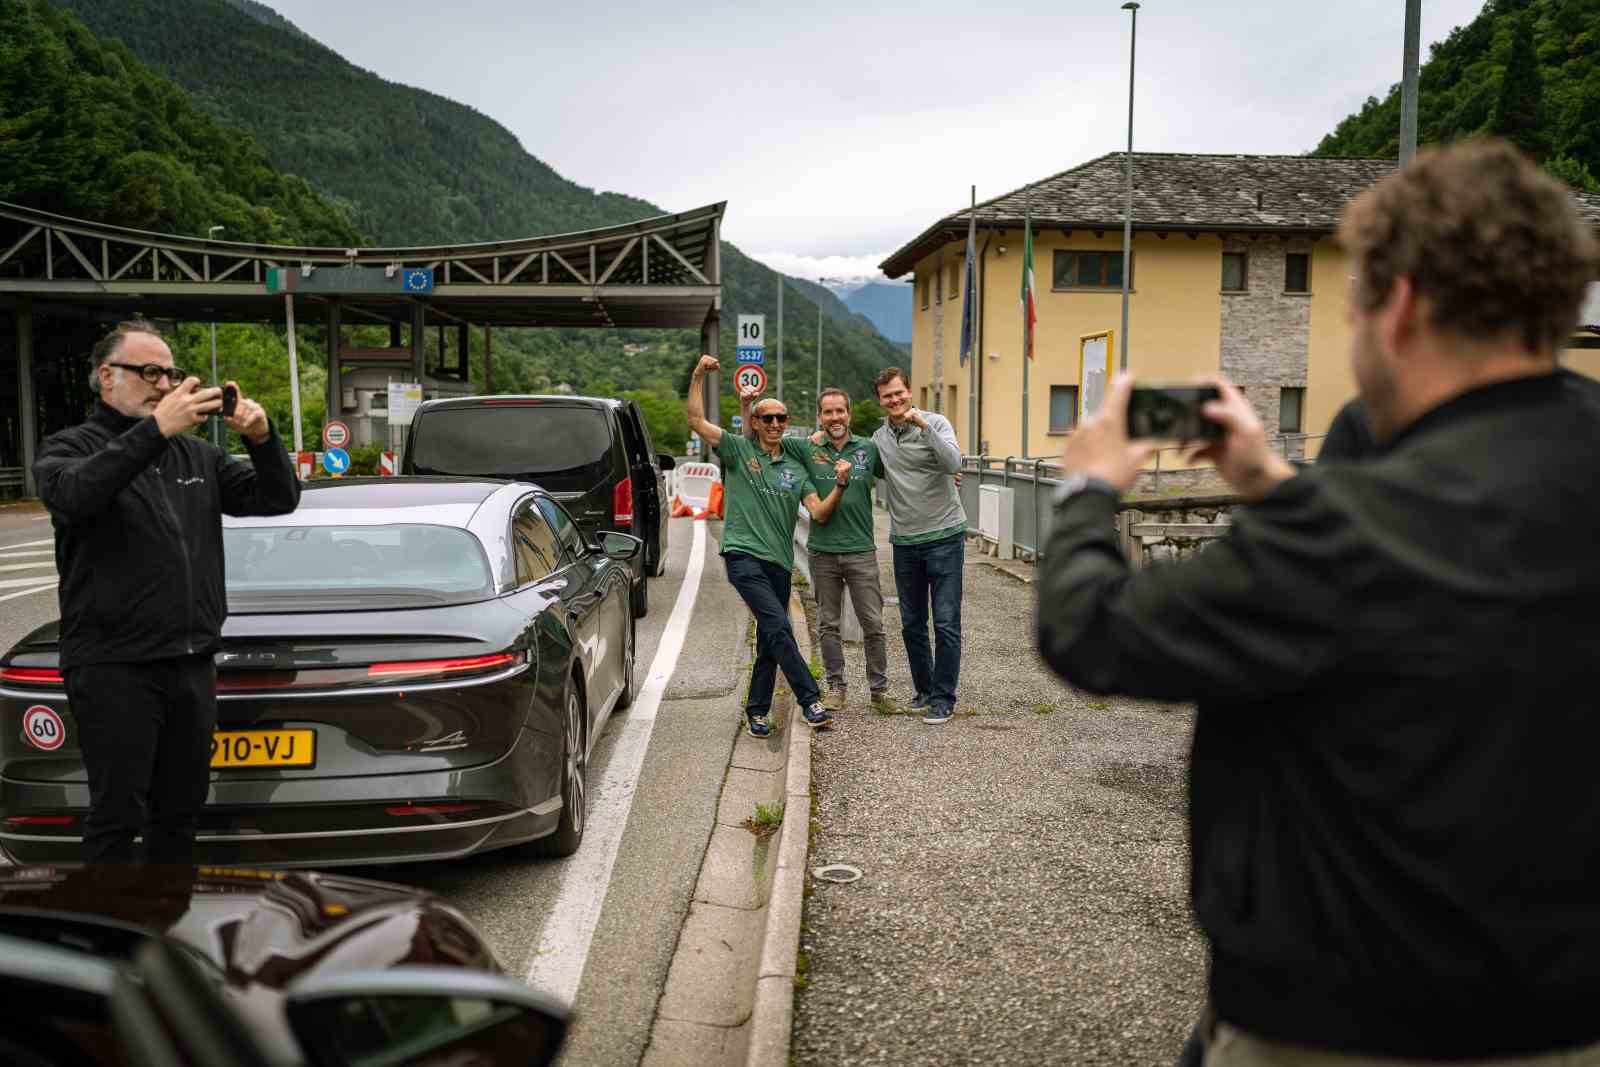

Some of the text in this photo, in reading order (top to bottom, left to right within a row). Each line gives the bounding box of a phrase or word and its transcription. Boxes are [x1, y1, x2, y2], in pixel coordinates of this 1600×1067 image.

[741, 323, 760, 339] 10
[740, 350, 762, 361] SS37
[741, 373, 759, 388] 30
[33, 718, 56, 737] 60
